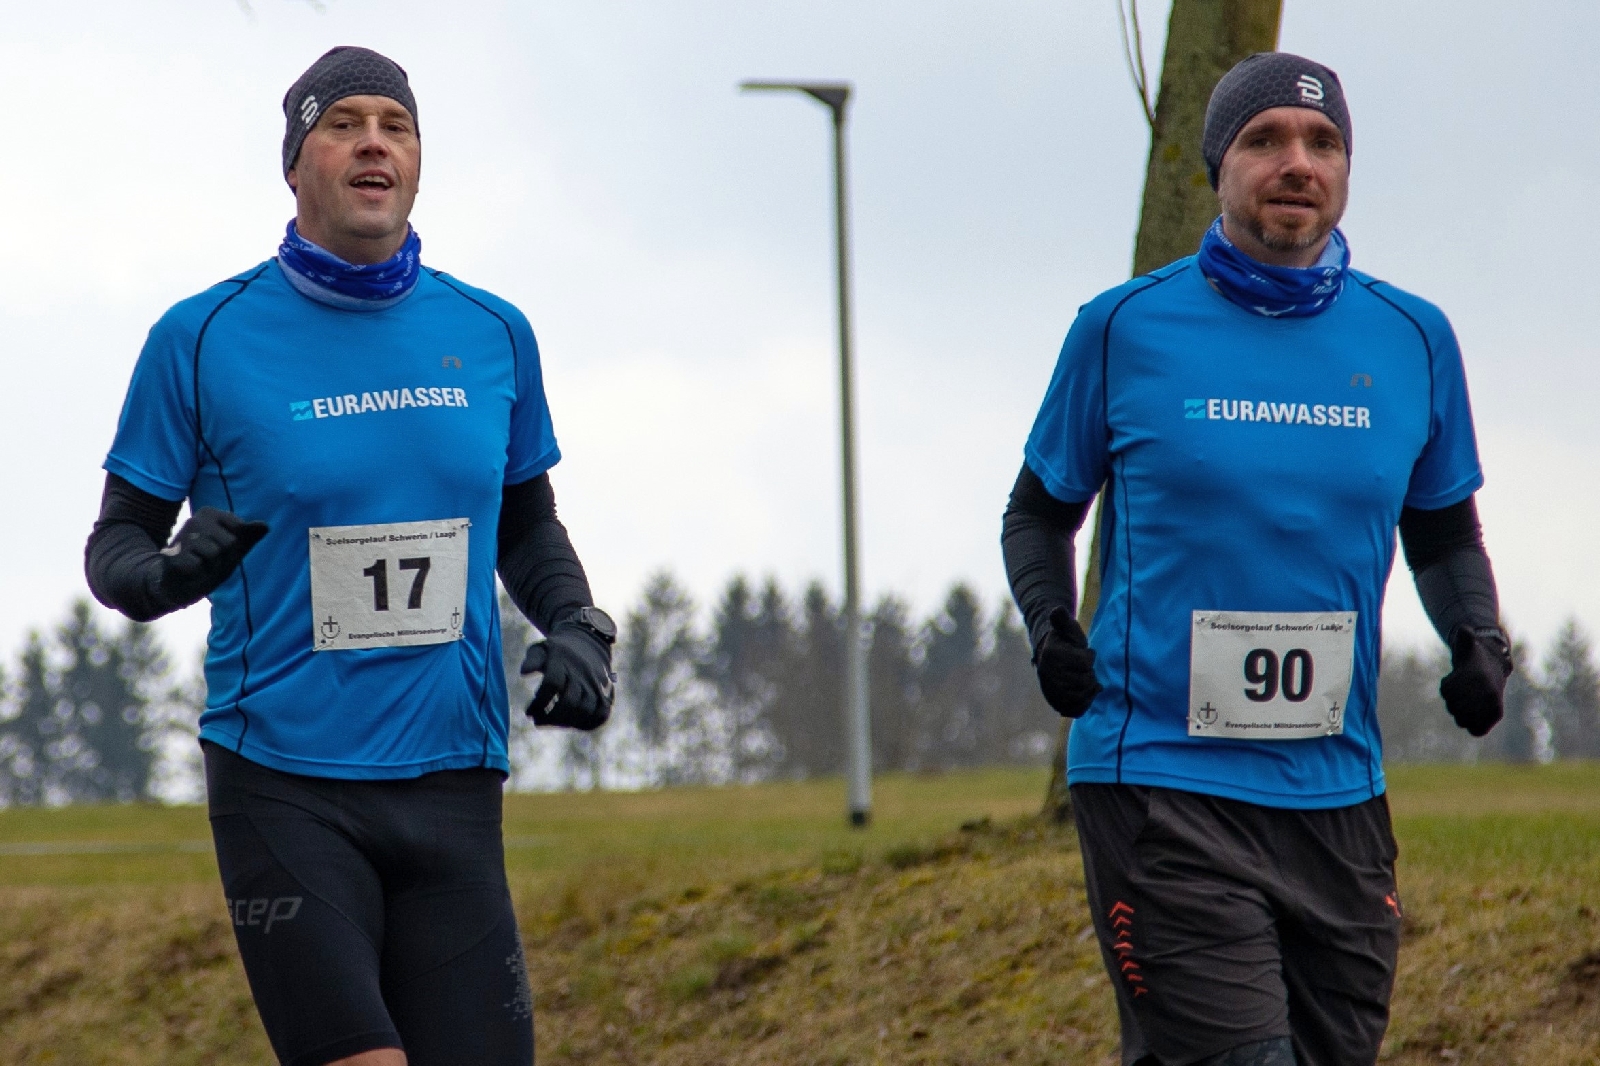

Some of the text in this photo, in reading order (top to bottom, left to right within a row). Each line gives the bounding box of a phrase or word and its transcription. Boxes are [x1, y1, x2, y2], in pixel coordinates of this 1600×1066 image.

[312, 387, 469, 419] EURAWASSER
[1206, 398, 1371, 429] EURAWASSER
[388, 533, 428, 542] Schwerin
[363, 557, 431, 612] 17
[1210, 622, 1272, 632] Seelsorgelauf
[1274, 623, 1313, 631] Schwerin
[1243, 648, 1315, 703] 90
[235, 896, 303, 934] cep
